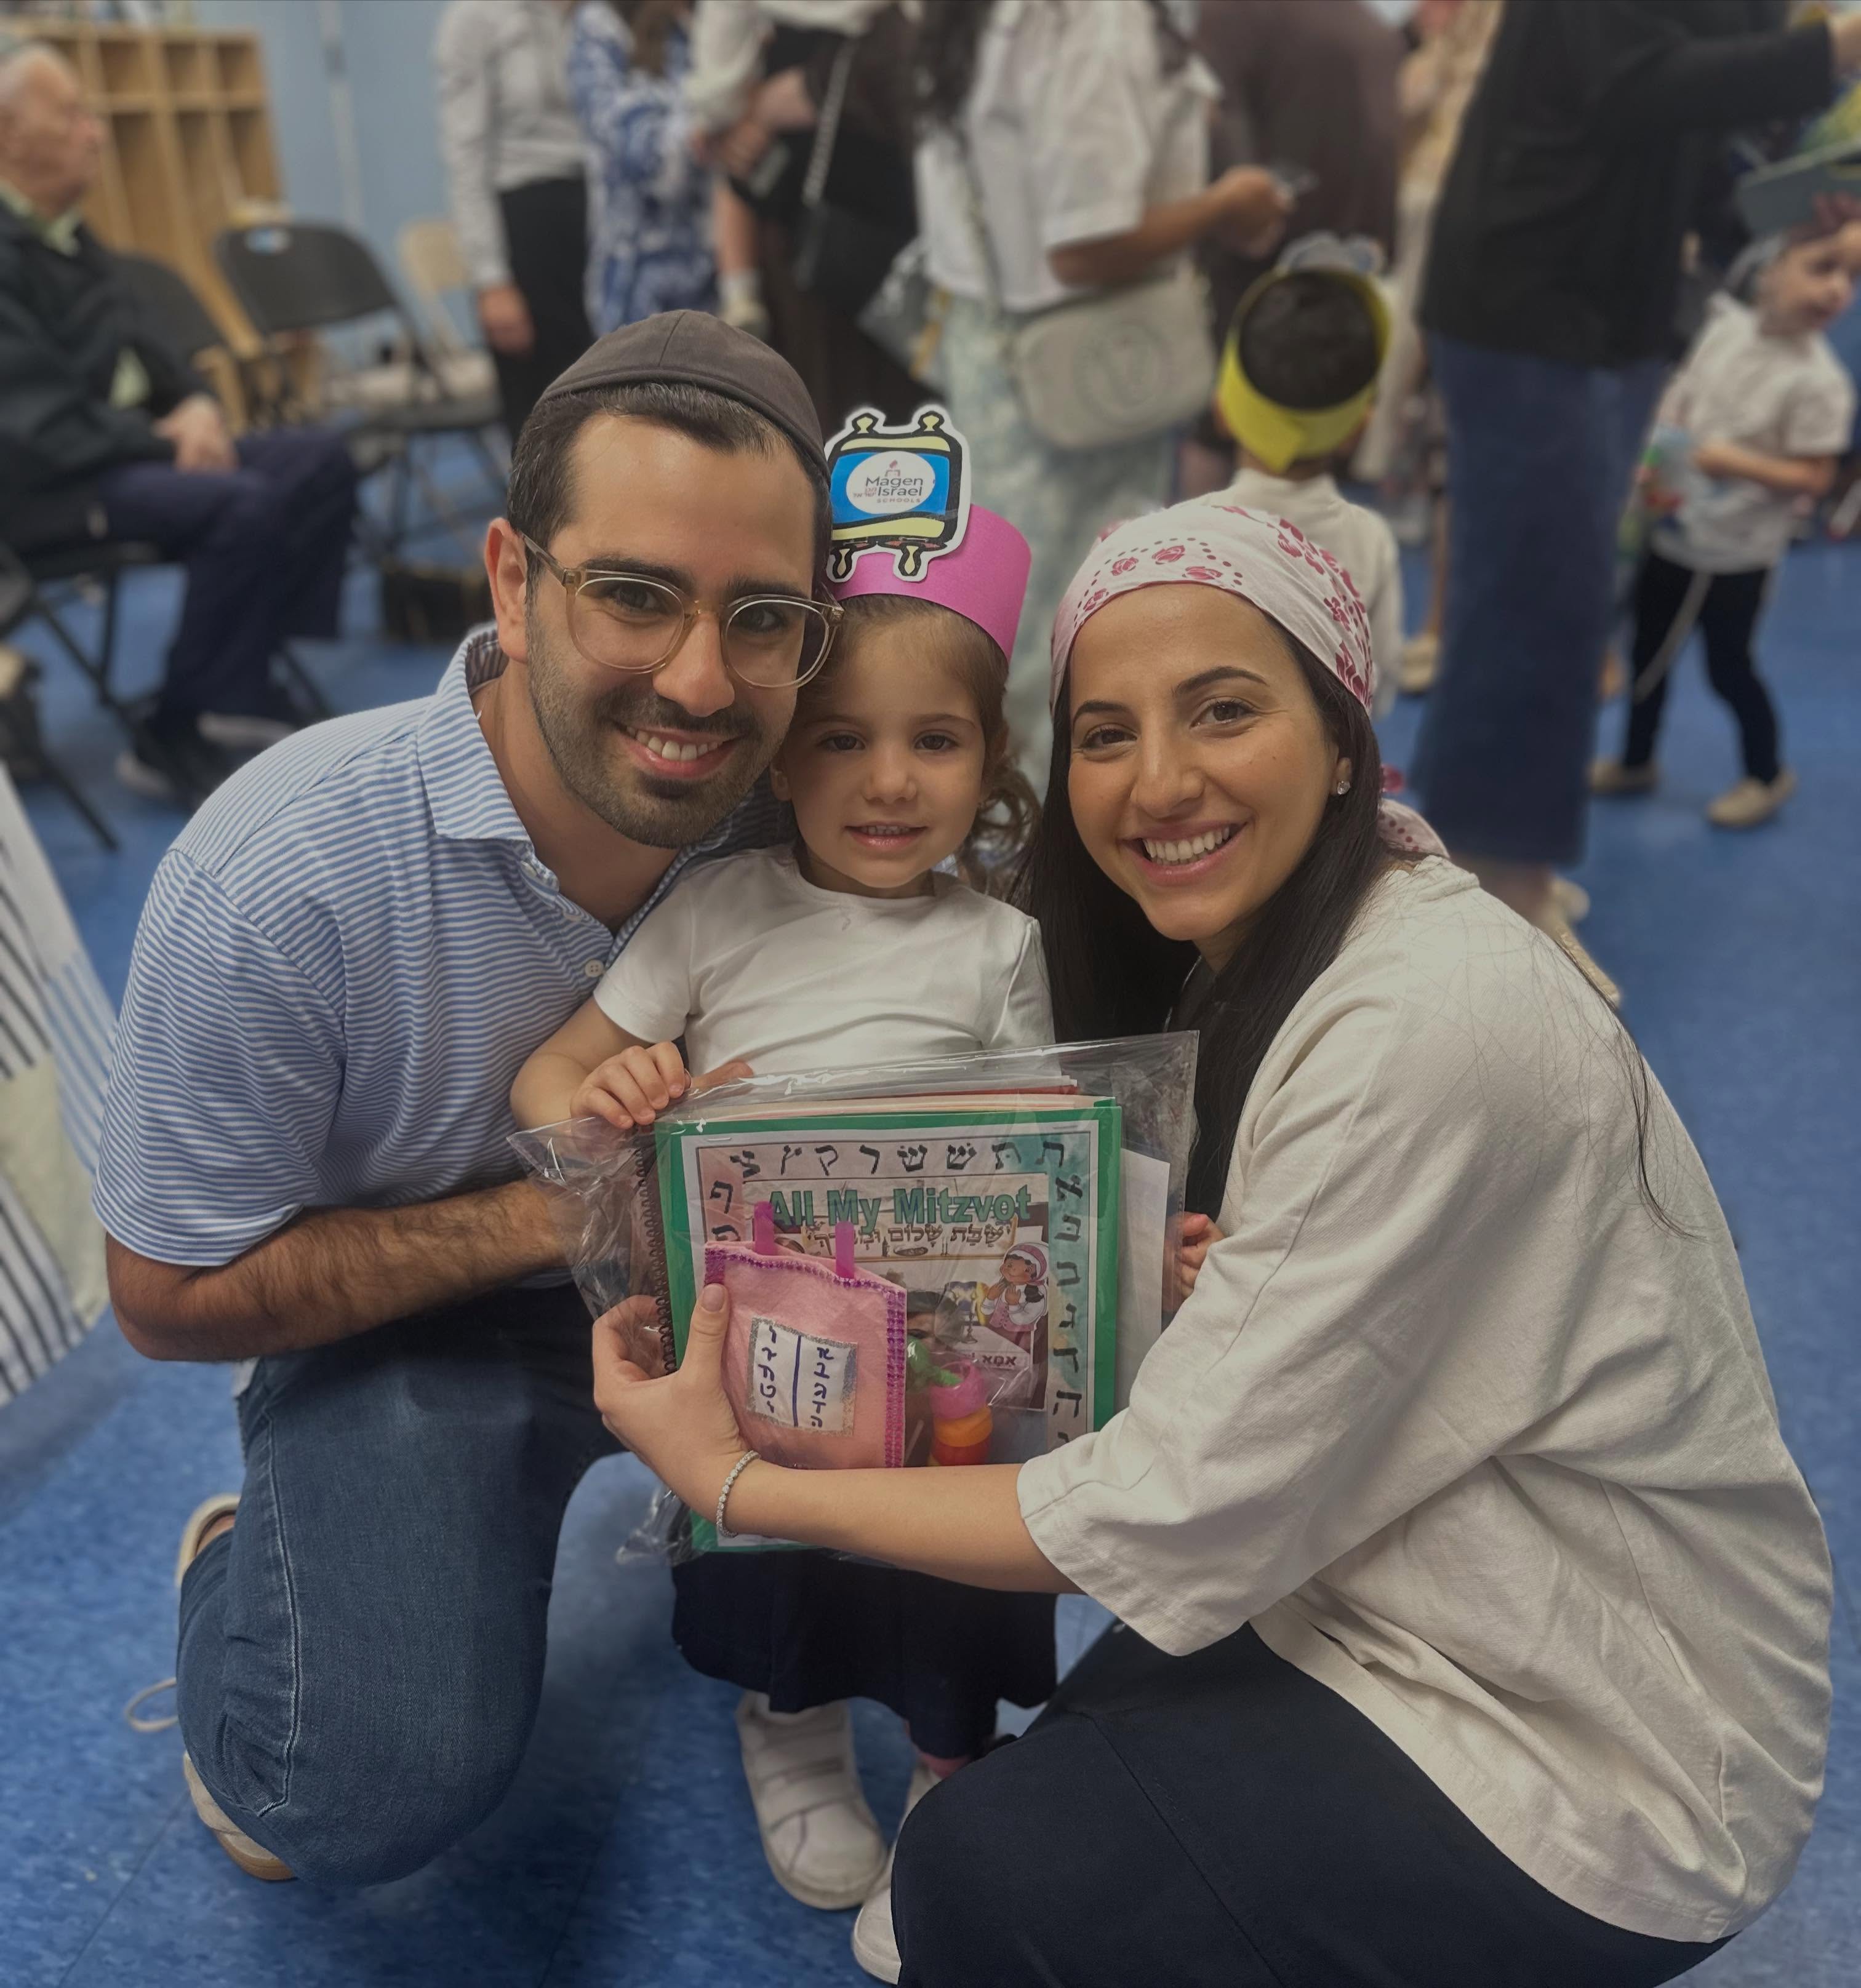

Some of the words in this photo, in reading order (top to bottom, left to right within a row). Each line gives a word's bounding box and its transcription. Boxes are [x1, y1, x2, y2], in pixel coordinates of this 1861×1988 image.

[865, 476, 923, 488] Magen
[878, 487, 922, 496] Israel
[769, 1191, 815, 1226] All
[826, 1189, 881, 1235] My
[892, 1184, 1031, 1225] Mitzvot
